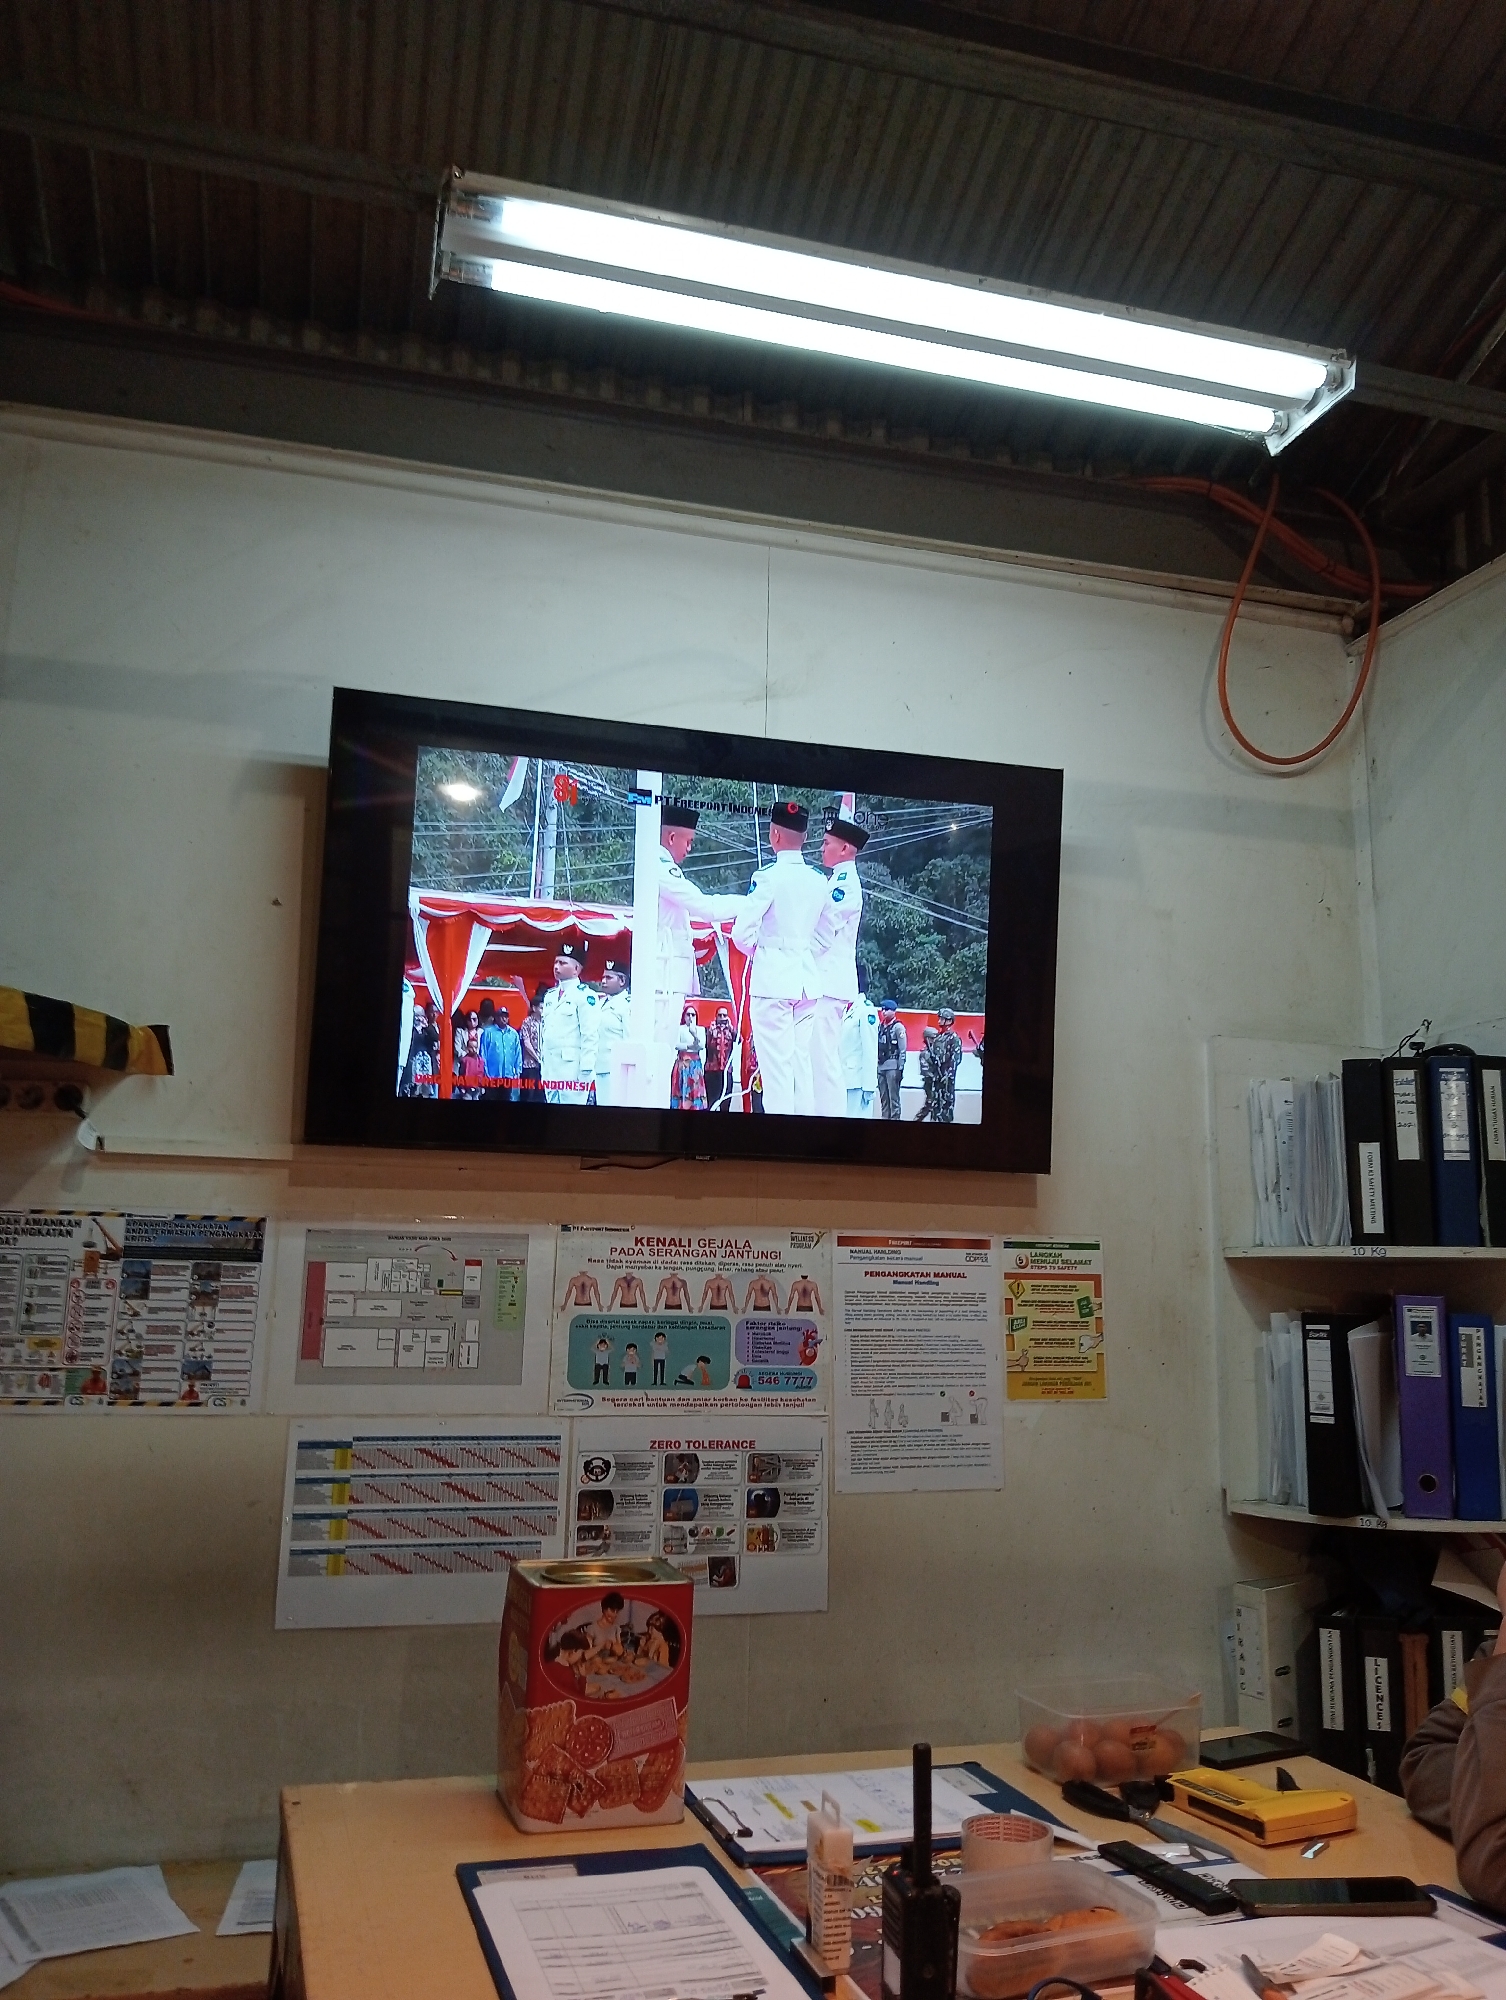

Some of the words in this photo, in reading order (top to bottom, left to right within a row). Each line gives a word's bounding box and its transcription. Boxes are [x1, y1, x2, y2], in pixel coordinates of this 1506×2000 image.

[654, 795, 672, 806] PT
[674, 797, 727, 812] FREEPORT
[482, 1077, 536, 1090] REPUBLIK
[538, 1079, 597, 1092] INDONESIA
[1368, 1177, 1376, 1197] SAFETY
[634, 1236, 691, 1249] KENALI
[698, 1238, 752, 1250] GEJALA
[610, 1247, 645, 1257] PADA
[648, 1248, 717, 1259] SERANGAN
[721, 1250, 782, 1261] JANTUNG!
[1352, 1247, 1366, 1256] 10
[1018, 1256, 1024, 1264] 5
[864, 1270, 931, 1278] PENGANGKATAN
[933, 1271, 967, 1279] MANUAL
[758, 1376, 780, 1385] 546
[784, 1376, 813, 1386] 7777
[649, 1440, 682, 1449] ZERO
[685, 1440, 756, 1450] TOLERANCE
[1359, 1517, 1372, 1527] 10
